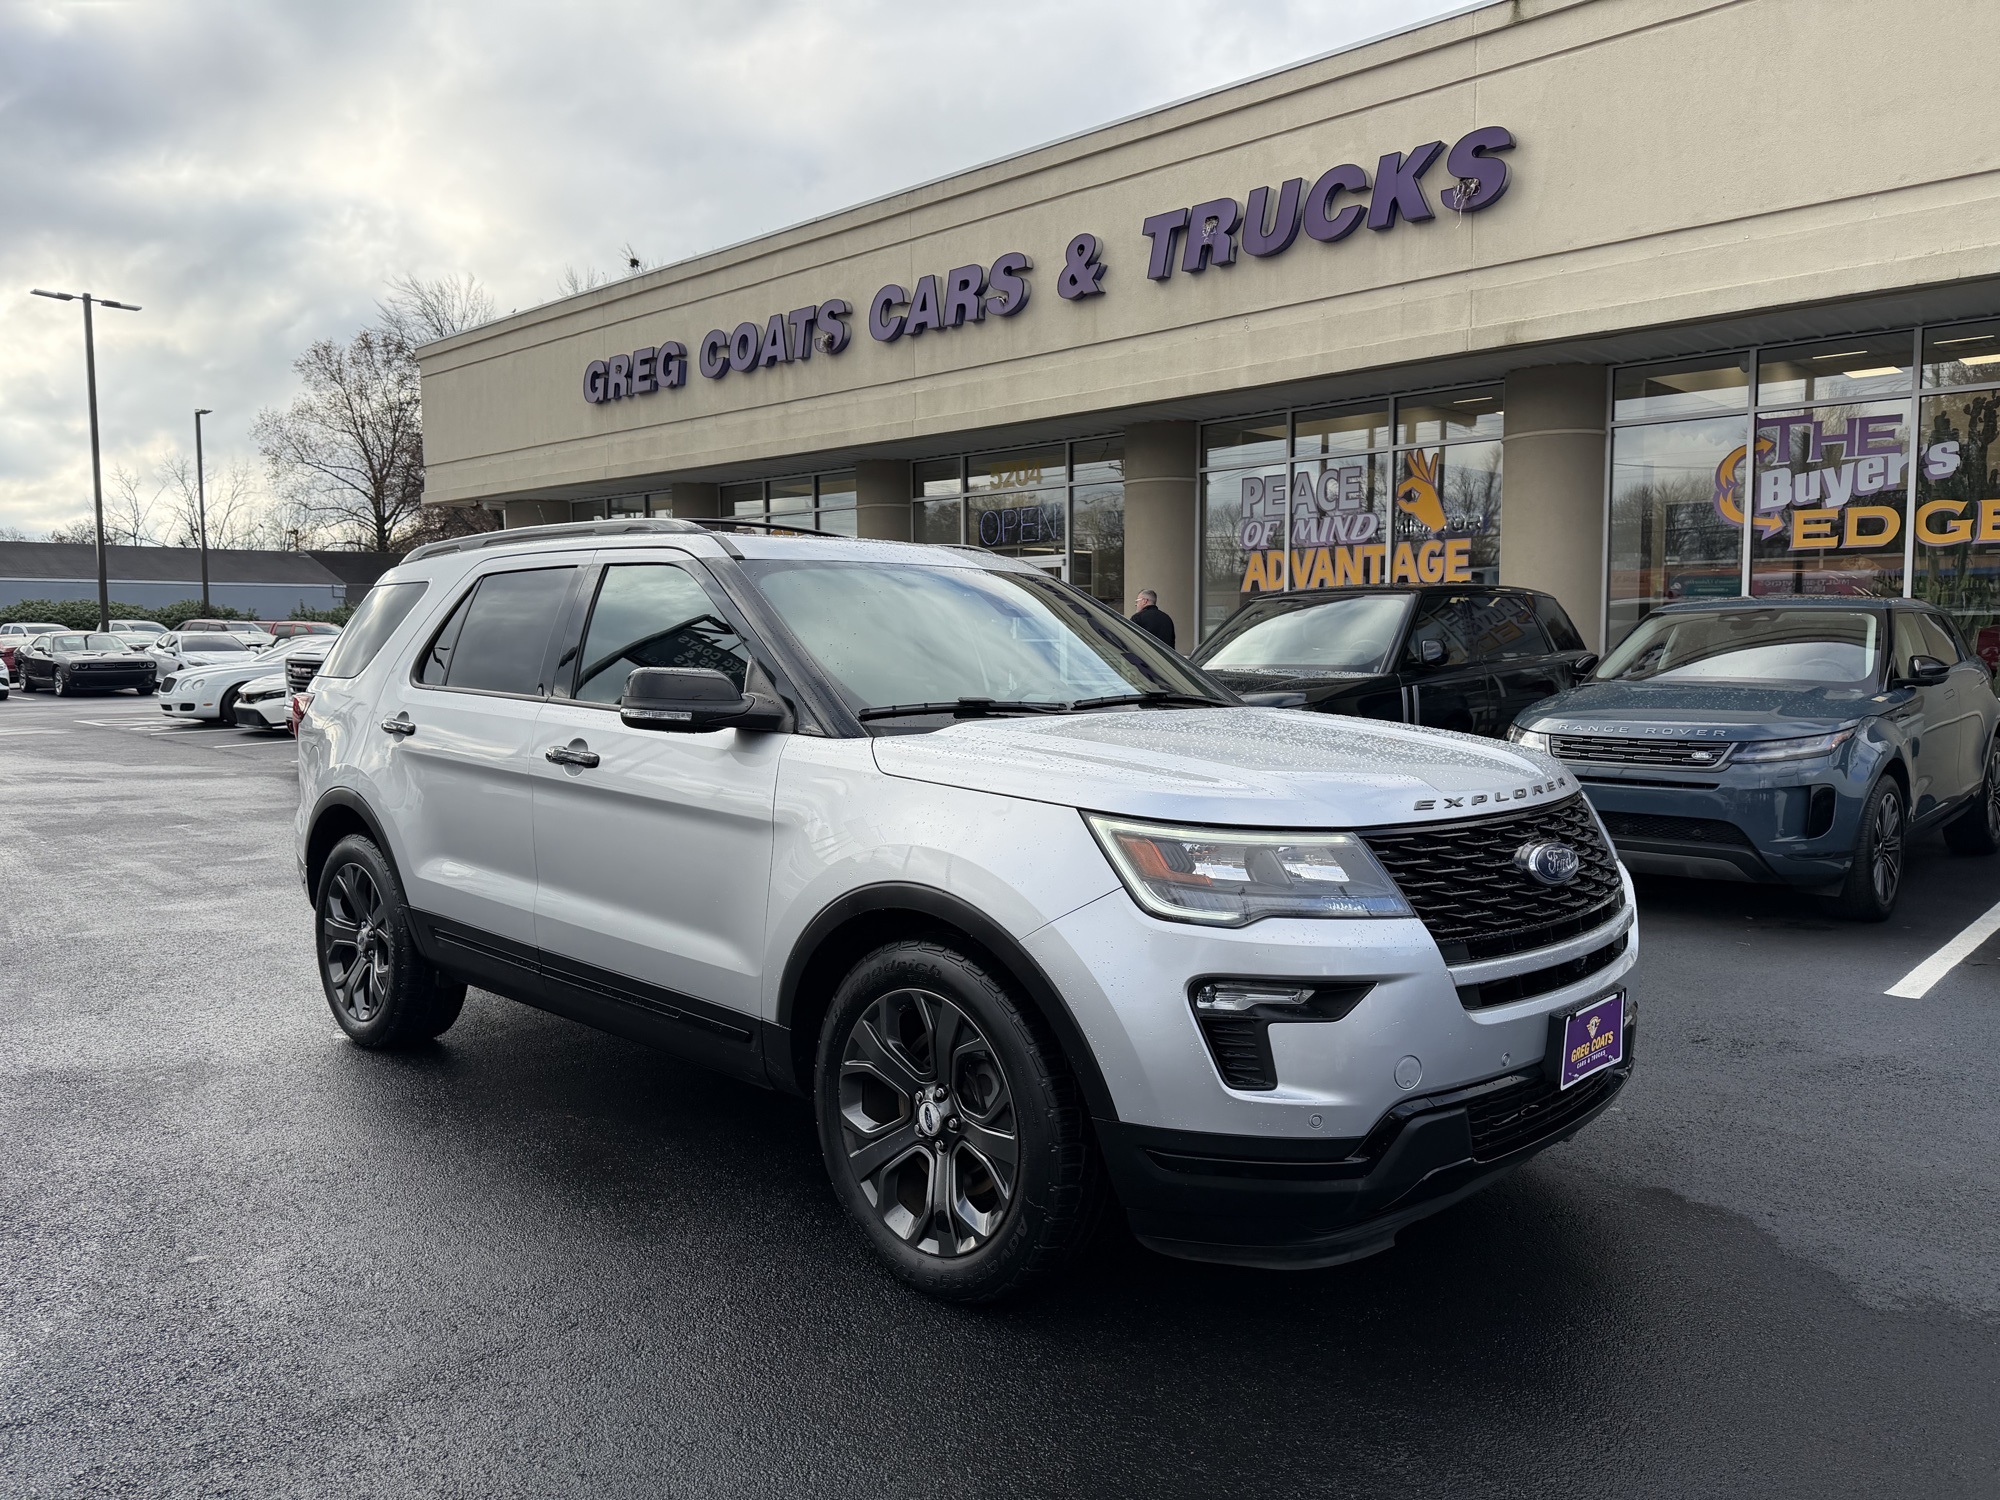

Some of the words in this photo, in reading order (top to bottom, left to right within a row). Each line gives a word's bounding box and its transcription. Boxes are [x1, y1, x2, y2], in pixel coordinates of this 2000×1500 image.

[583, 340, 687, 404] GREG
[699, 298, 853, 380] COATS
[869, 251, 1033, 343] CARS
[1057, 233, 1108, 301] &
[1142, 125, 1516, 281] TRUCKS
[1757, 413, 1903, 467] THE
[990, 461, 1042, 490] 5204
[1241, 466, 1362, 518] PEACE
[980, 504, 1057, 547] OPEN
[1240, 519, 1282, 550] OF
[1291, 511, 1380, 547] MIND
[1240, 538, 1472, 593] ADVANTAGE
[1558, 723, 1629, 734] RANGE
[1645, 727, 1726, 737] ROVER
[1413, 777, 1567, 811] EXPLORER
[1547, 848, 1578, 874] Ford
[1571, 1042, 1590, 1062] GREG
[1591, 1031, 1614, 1052] COATS
